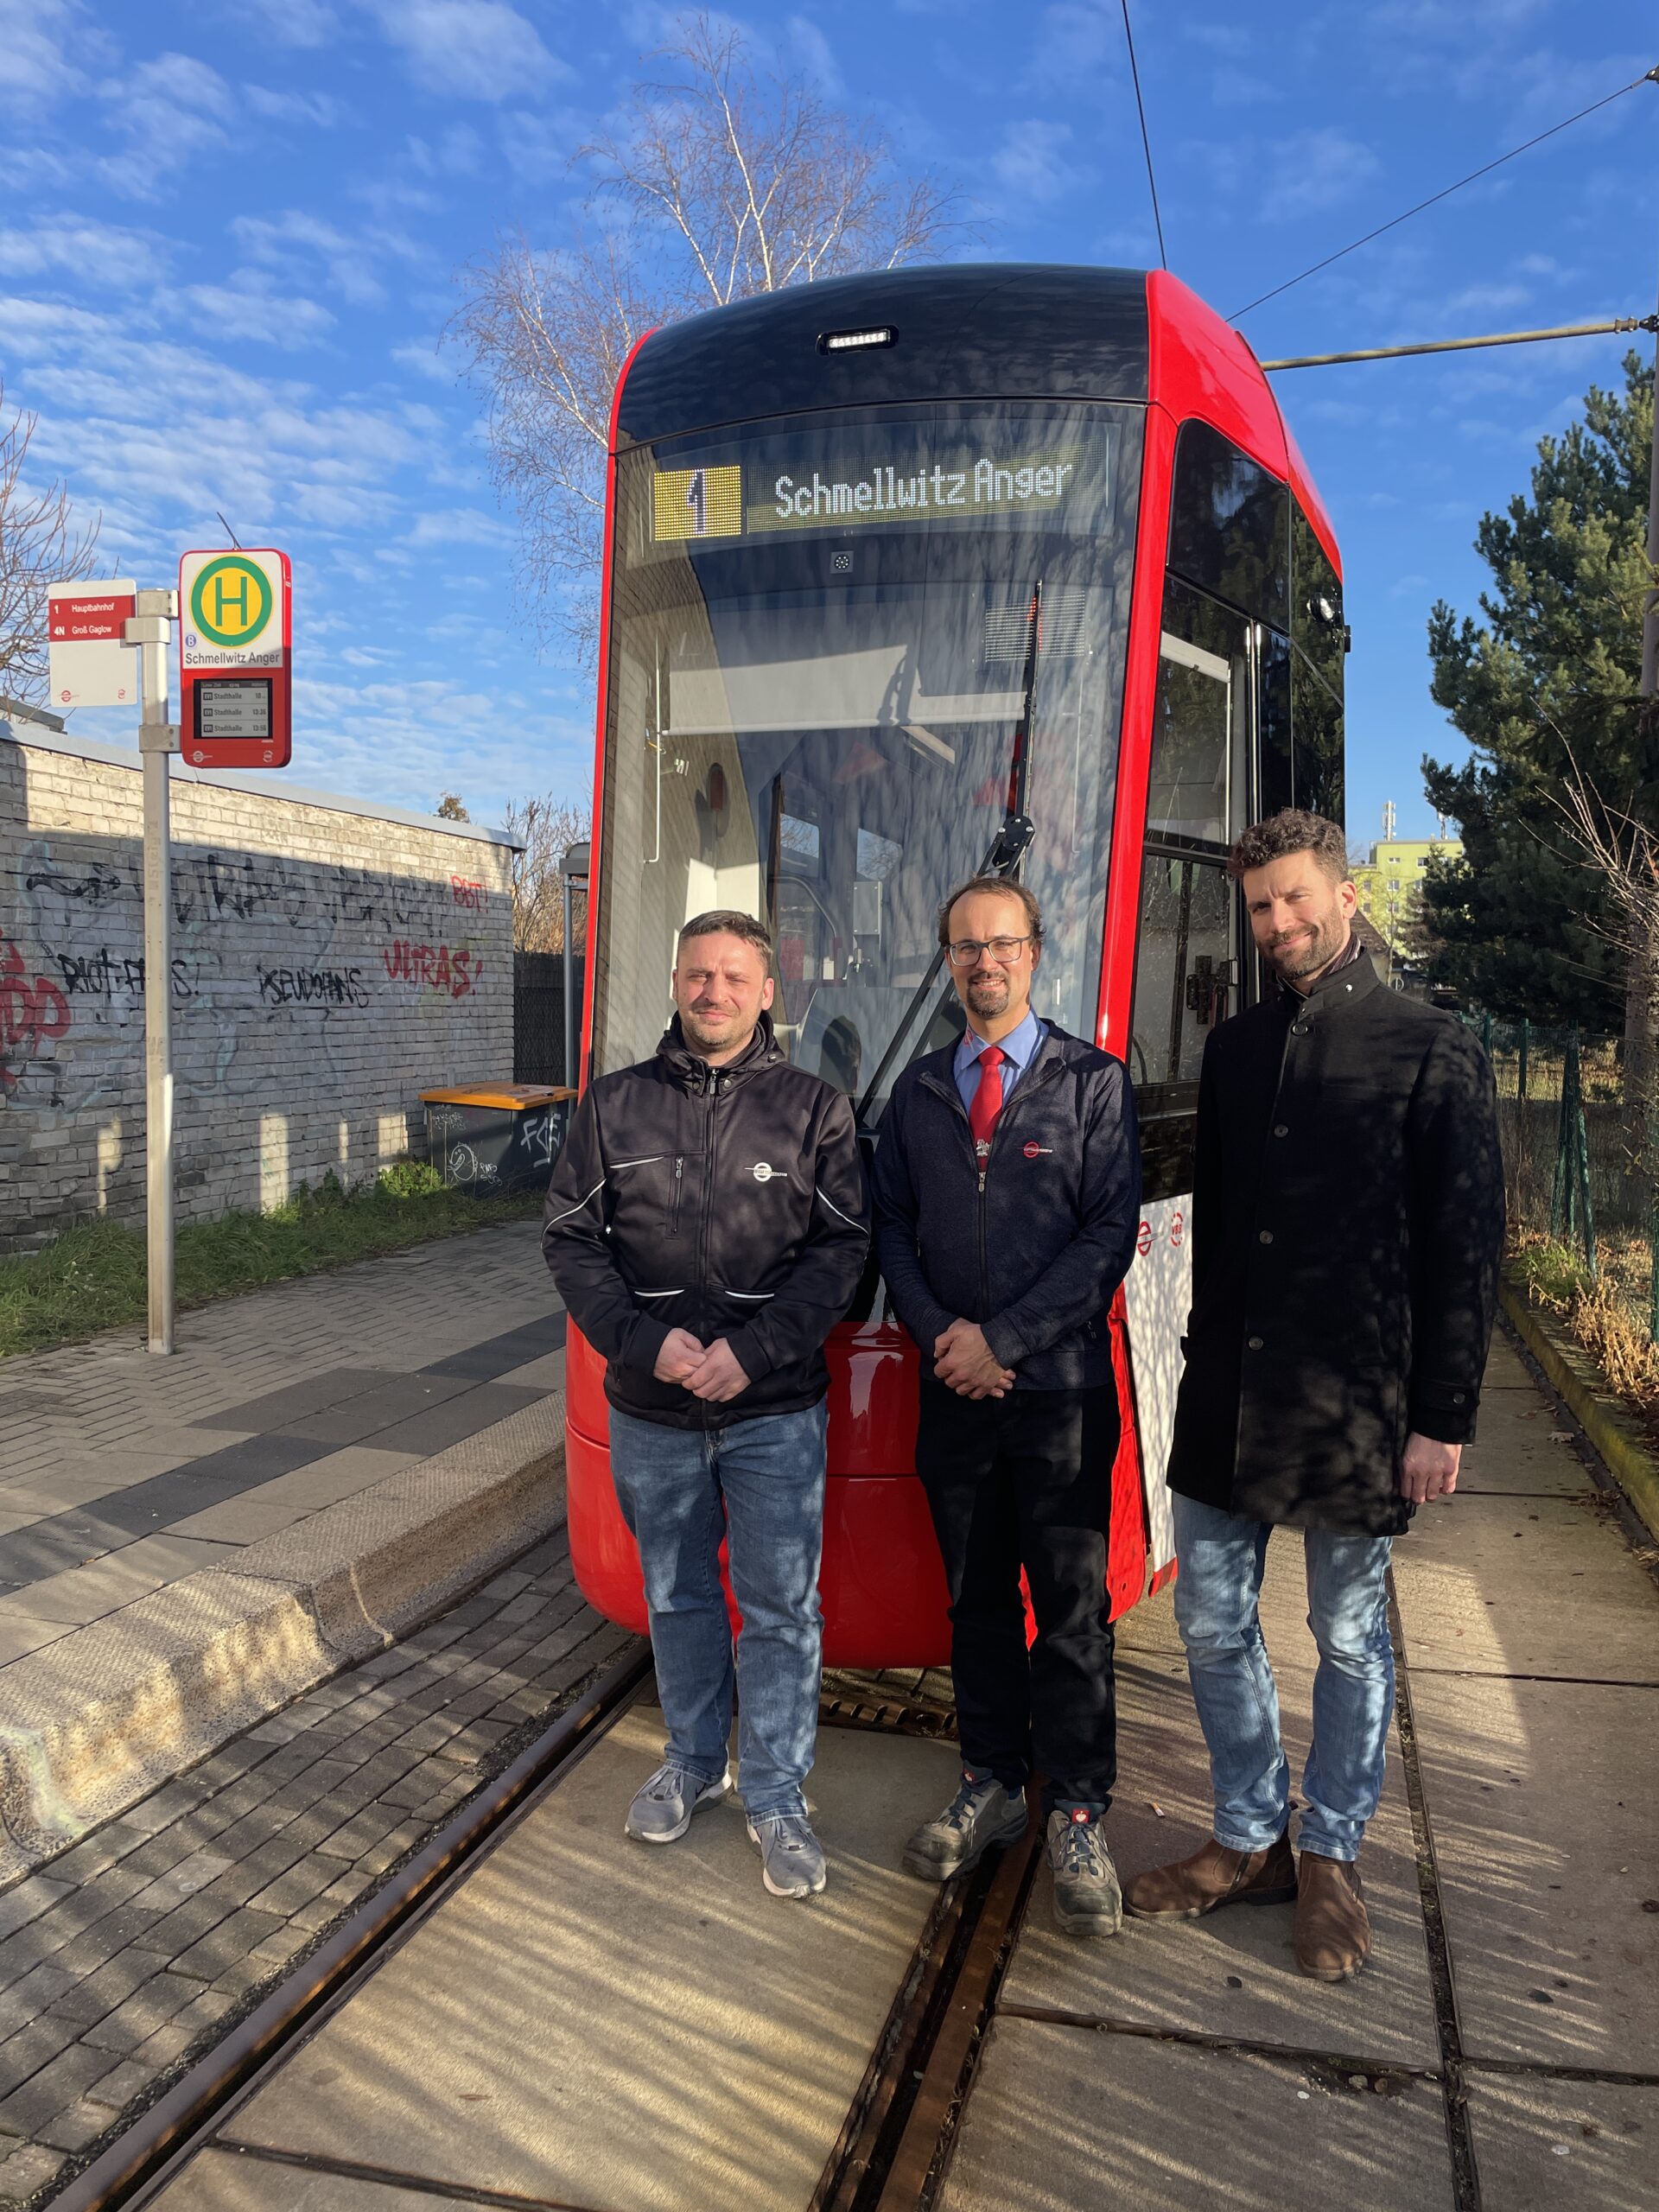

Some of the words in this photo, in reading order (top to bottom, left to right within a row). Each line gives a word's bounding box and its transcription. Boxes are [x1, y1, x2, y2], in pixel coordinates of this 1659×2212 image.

[685, 467, 706, 536] 1
[775, 465, 966, 518] Schmellwitz
[973, 457, 1072, 503] Anger
[214, 576, 248, 626] H
[54, 604, 60, 614] 1
[72, 602, 115, 613] Hauptbahnhof
[54, 626, 66, 635] 4N
[72, 626, 88, 635] Groß
[89, 625, 112, 635] Gaglow
[185, 652, 246, 664] Schmellwitz
[248, 652, 280, 665] Anger
